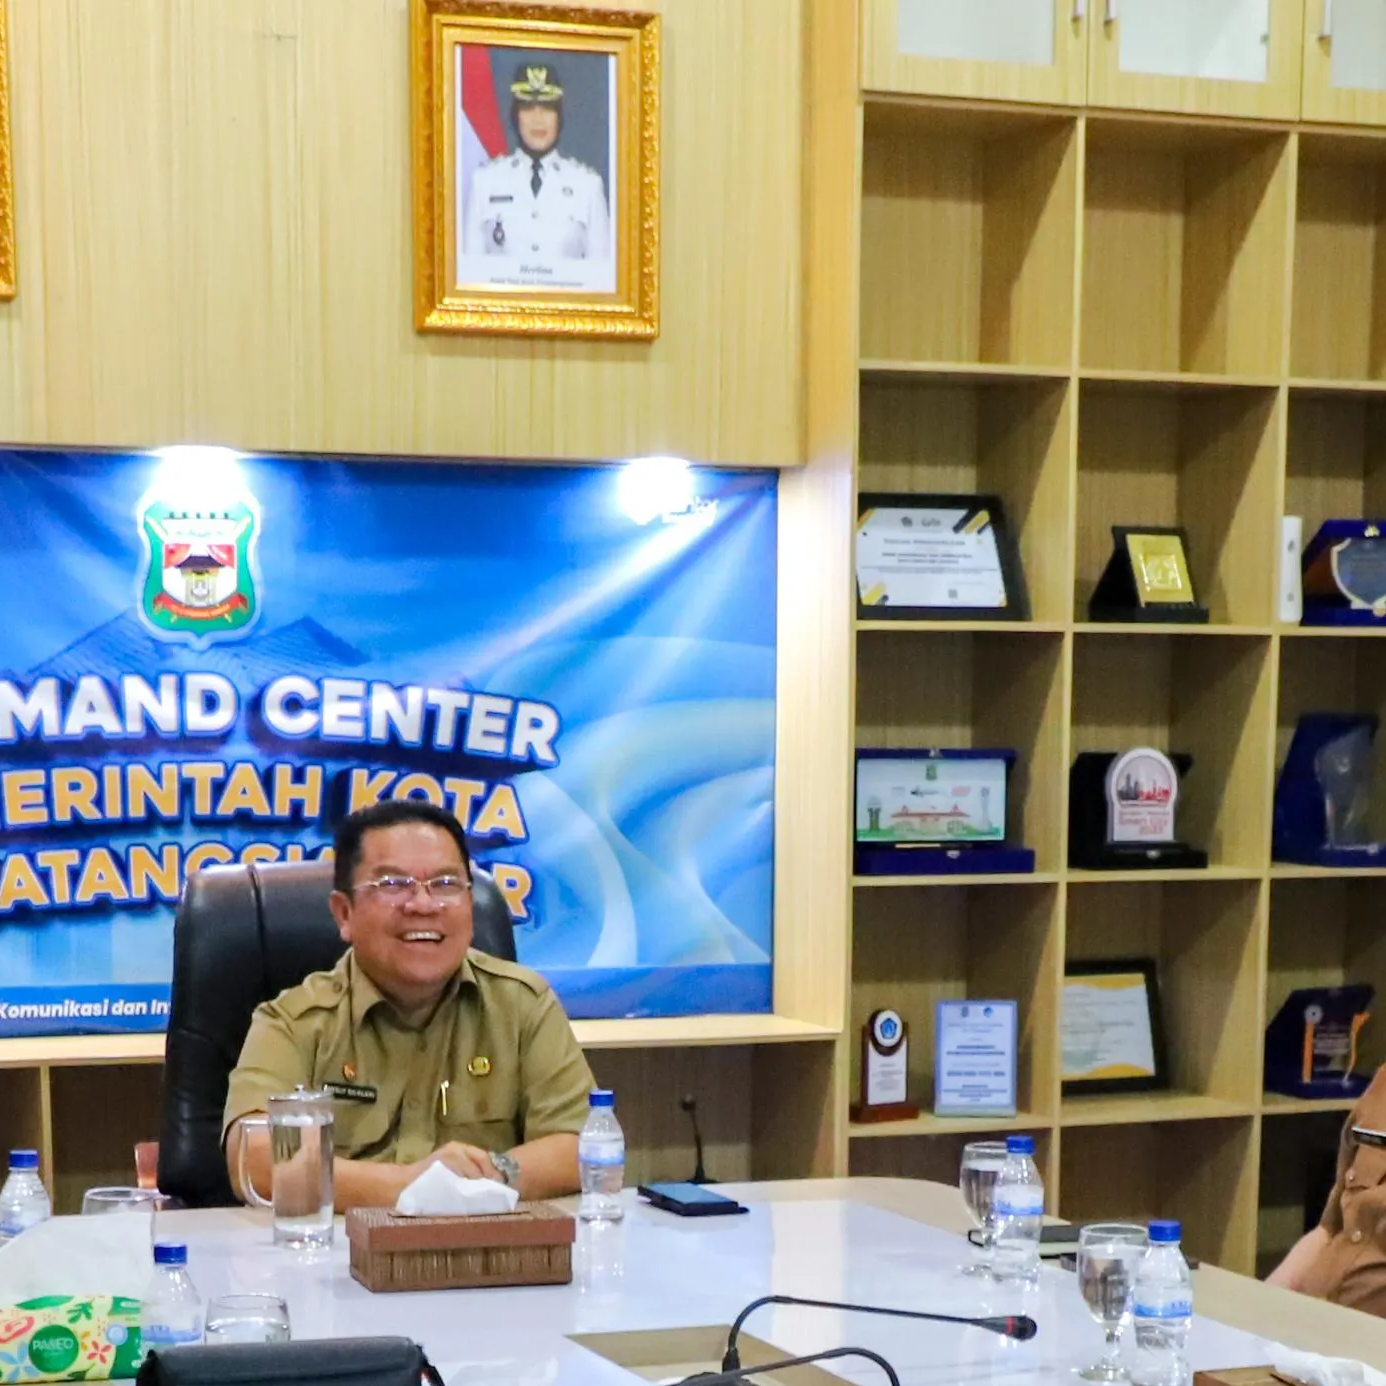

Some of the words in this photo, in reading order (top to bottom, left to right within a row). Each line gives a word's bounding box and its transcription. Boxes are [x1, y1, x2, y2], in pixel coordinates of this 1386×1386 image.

[265, 678, 559, 763] CENTER
[111, 998, 148, 1017] dan
[32, 1337, 74, 1352] PASEO
